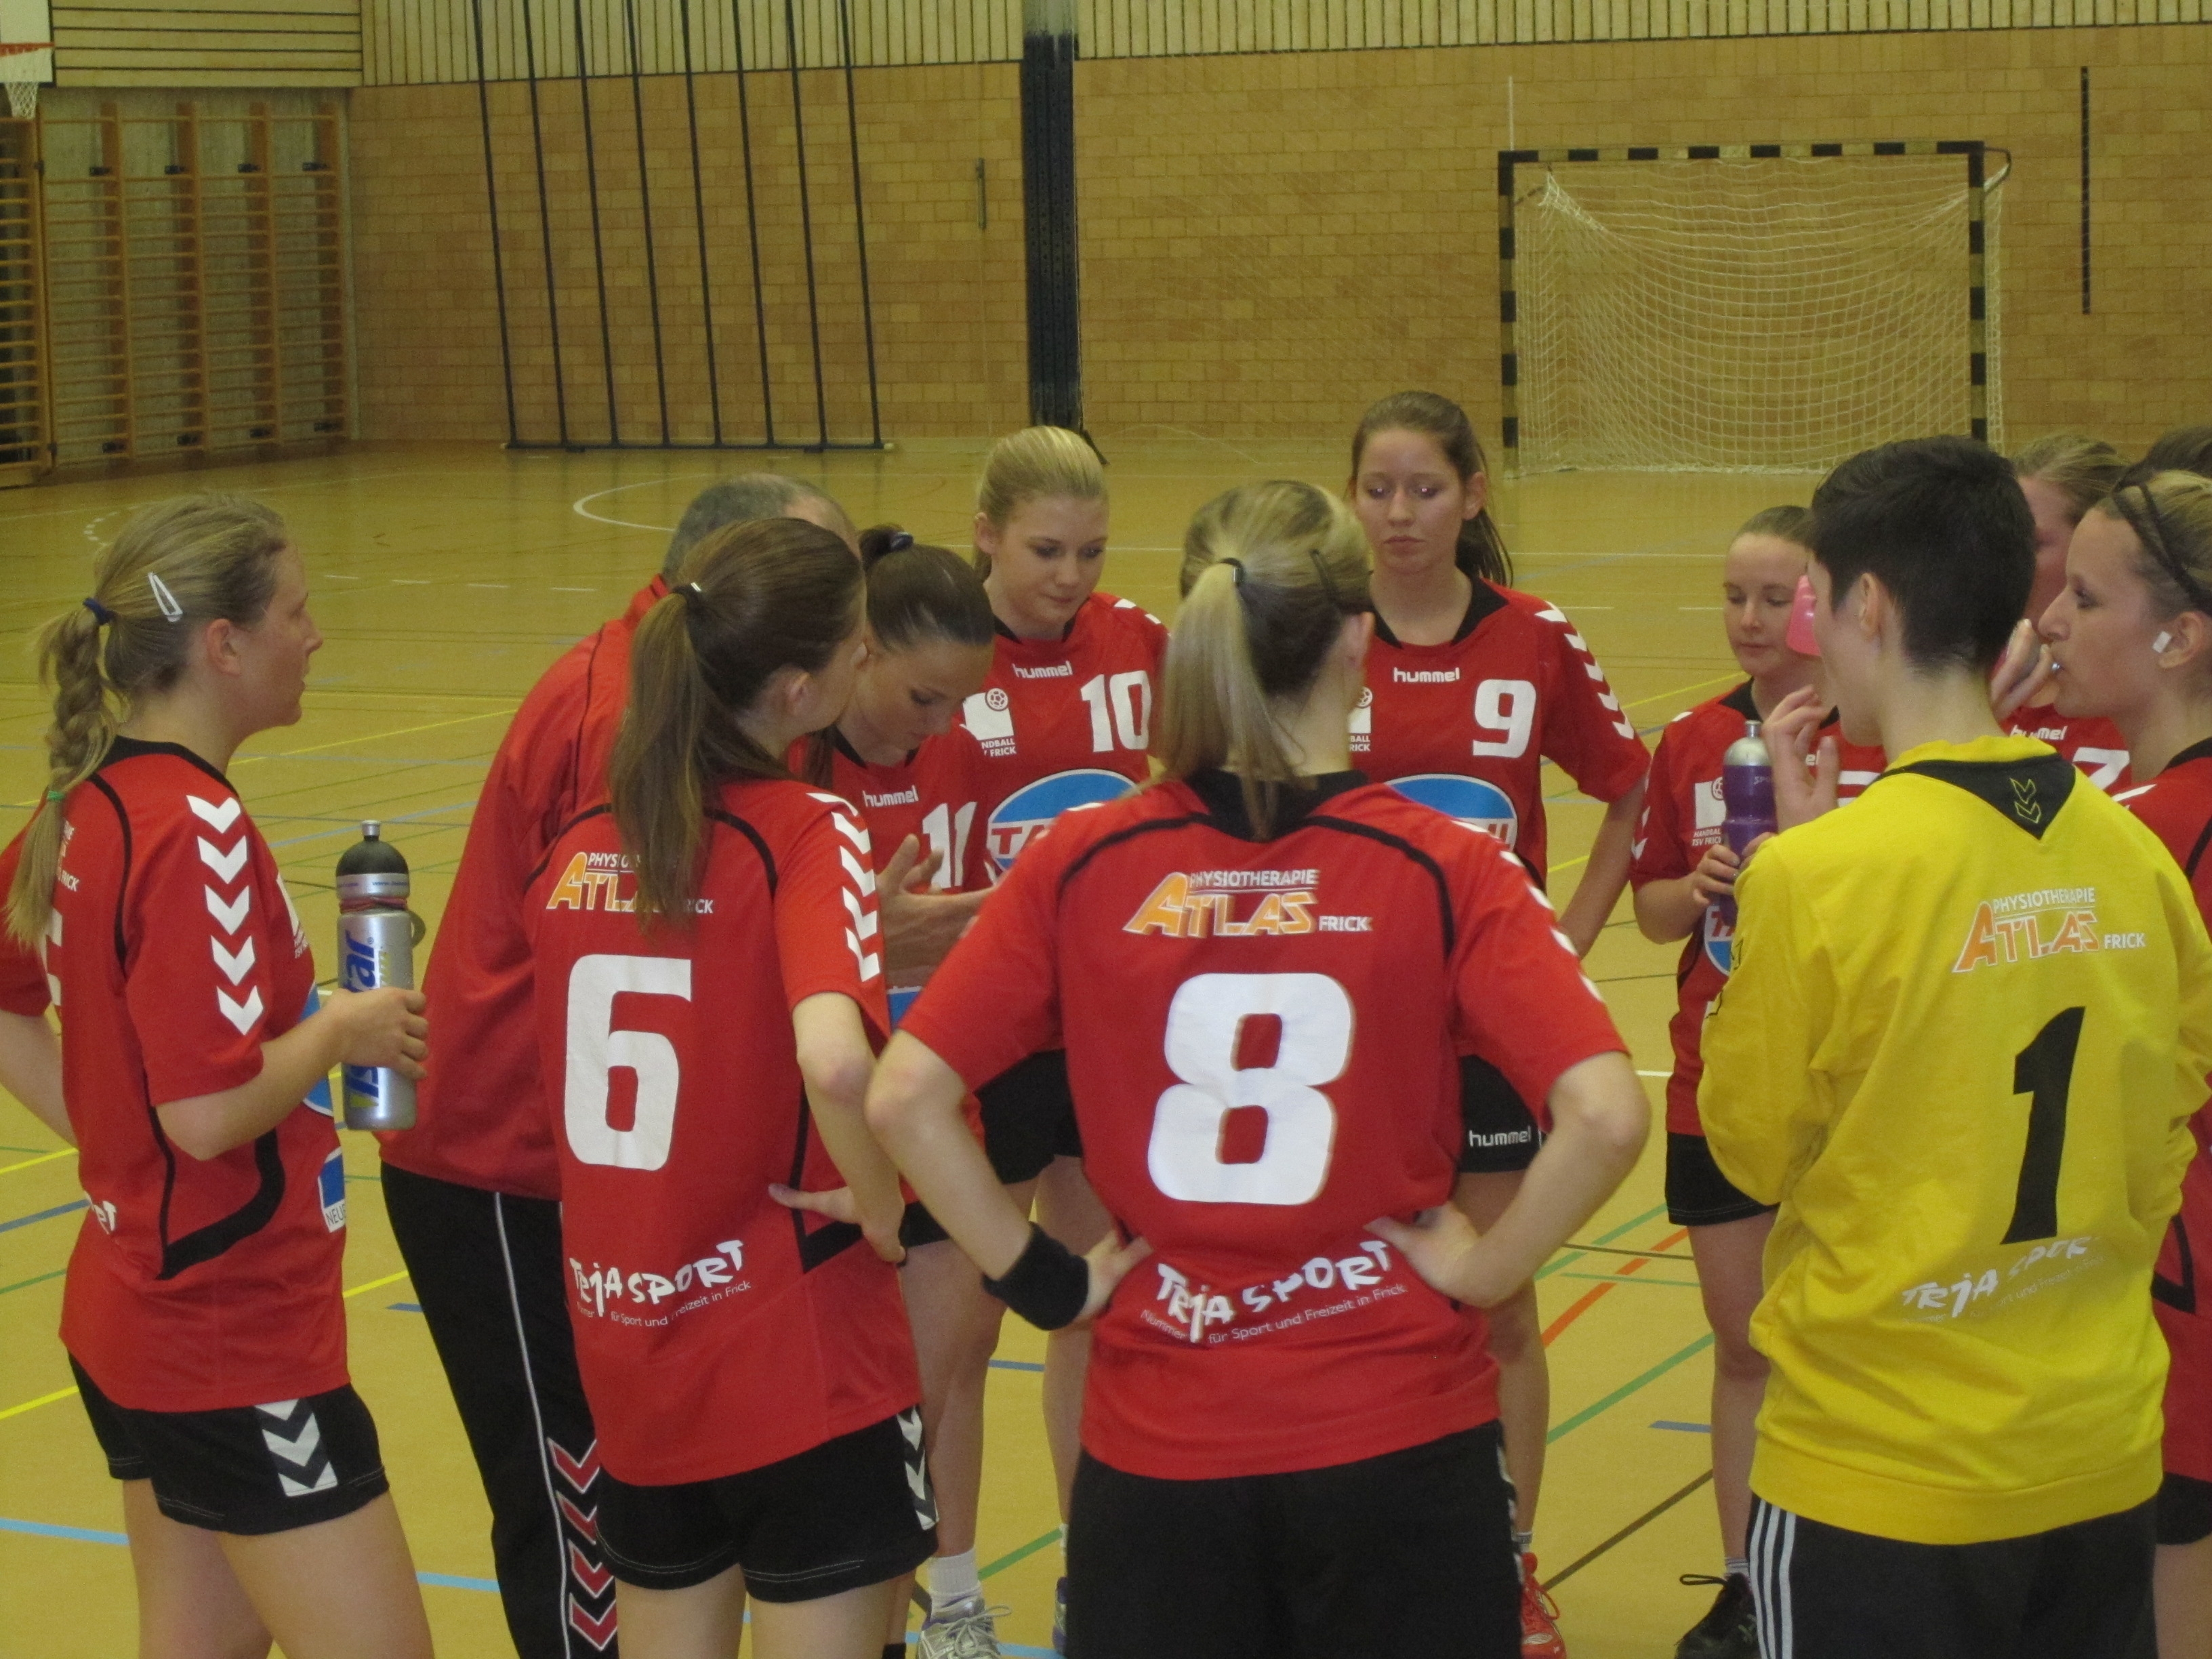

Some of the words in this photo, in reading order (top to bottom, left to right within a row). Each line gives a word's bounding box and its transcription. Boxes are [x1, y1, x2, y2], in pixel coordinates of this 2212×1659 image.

[1012, 661, 1072, 678] hummel
[1393, 667, 1459, 682] hummel
[1080, 670, 1151, 752] 10
[1473, 679, 1536, 758] 9
[981, 737, 1015, 748] NDBALL
[990, 746, 1017, 757] FRICK
[2072, 747, 2130, 790] 7
[863, 785, 919, 808] hummel
[1694, 828, 1721, 838] HANDBAL
[1190, 869, 1319, 888] PHYSIOTHERAPIE
[1122, 872, 1318, 939] ATLAS
[1318, 916, 1373, 932] FRICK
[1992, 887, 2095, 914] PHYSIOTHERAPIE
[1952, 901, 2100, 972] ATLAS
[2104, 933, 2145, 949] FRICK
[565, 954, 692, 1172] 6
[1148, 972, 1355, 1205] 8
[1469, 1125, 1531, 1147] hummel
[1999, 1006, 2086, 1245] 1
[644, 1315, 669, 1328] und
[712, 1292, 723, 1303] in
[724, 1280, 752, 1298] Frick
[1208, 1332, 1228, 1345] für
[1231, 1322, 1273, 1340] Sport
[1275, 1313, 1301, 1330] und
[1304, 1300, 1355, 1321] Freizeit
[1357, 1296, 1370, 1307] in
[1372, 1283, 1408, 1300] Frick
